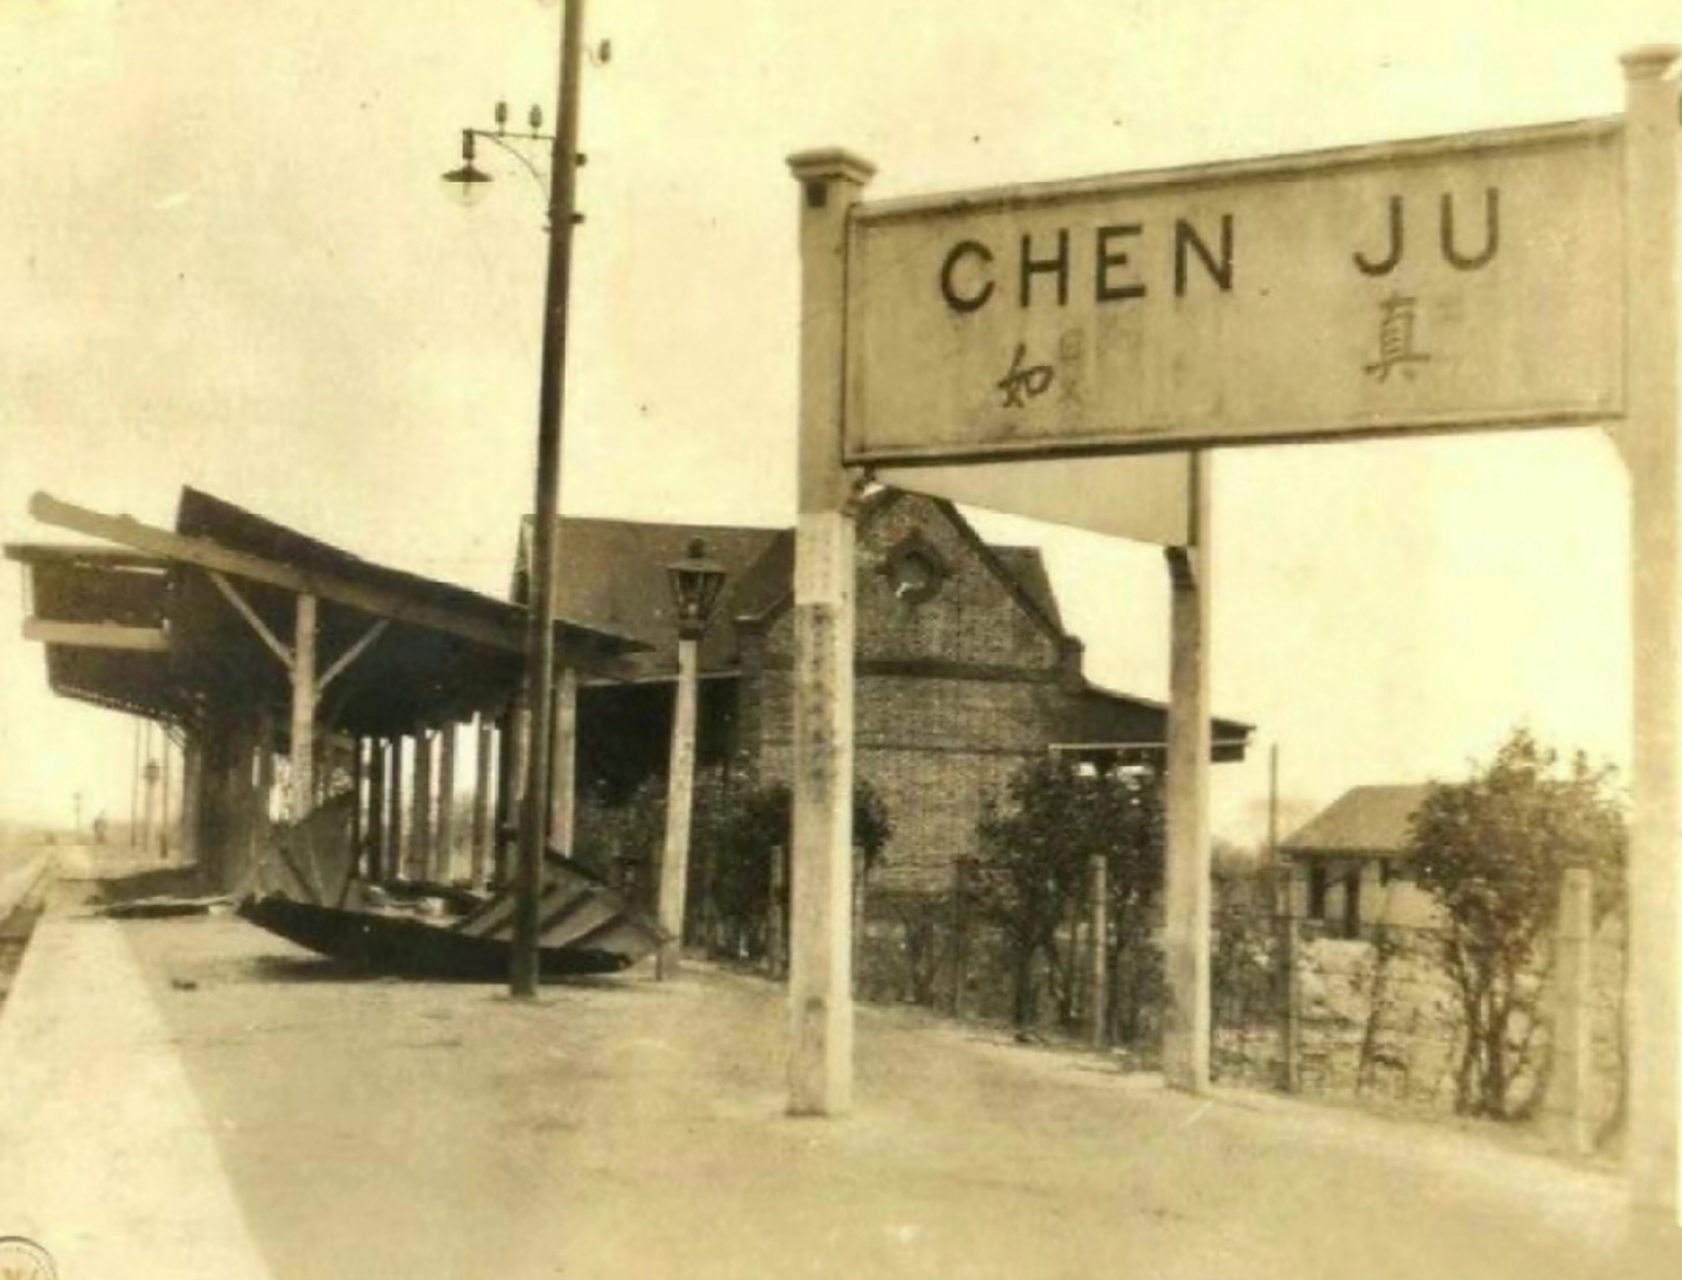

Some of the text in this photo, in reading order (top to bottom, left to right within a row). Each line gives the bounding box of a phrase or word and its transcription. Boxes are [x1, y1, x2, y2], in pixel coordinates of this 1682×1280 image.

[940, 186, 1499, 314] CHEN JU
[998, 341, 1054, 409] 如
[1362, 291, 1431, 384] 真
